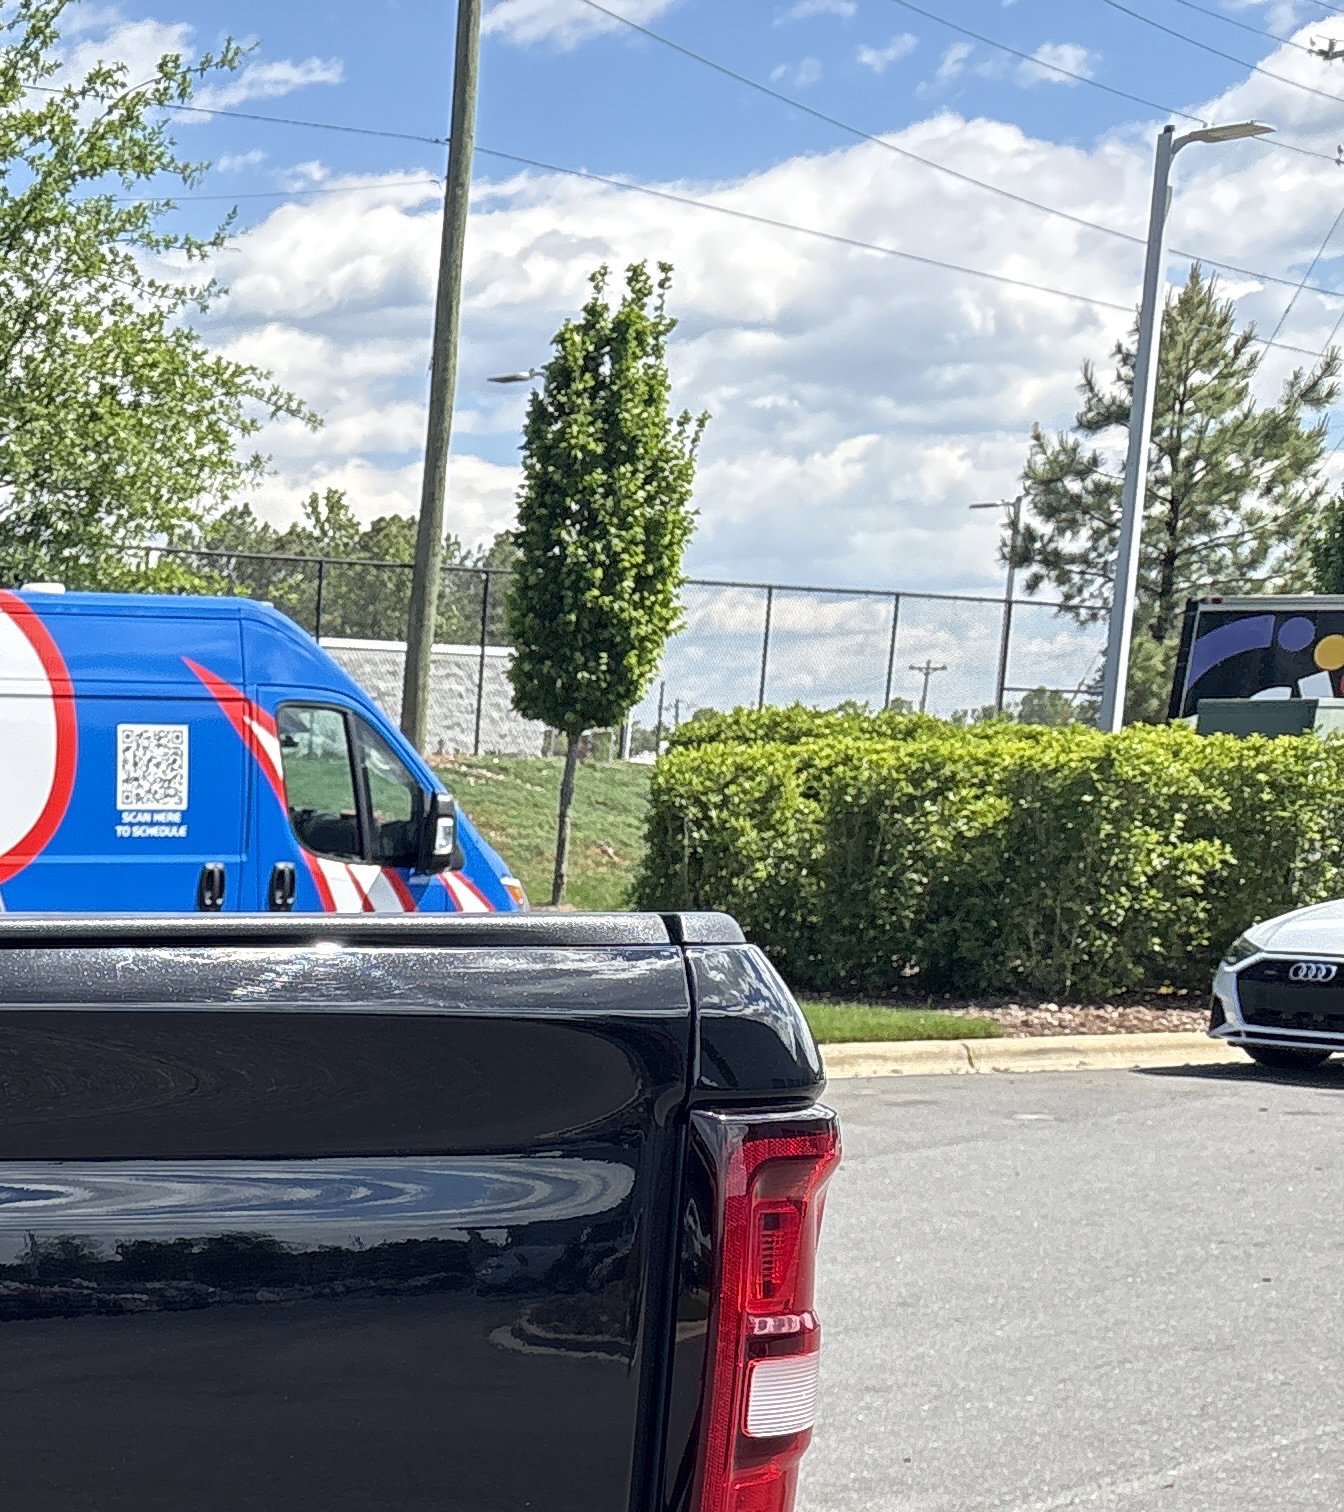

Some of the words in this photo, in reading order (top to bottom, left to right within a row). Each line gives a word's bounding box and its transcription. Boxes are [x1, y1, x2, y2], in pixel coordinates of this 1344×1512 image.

[122, 811, 152, 823] SCAN
[153, 811, 182, 823] HERE
[115, 824, 131, 838] TO
[132, 824, 188, 838] SCHEDULE
